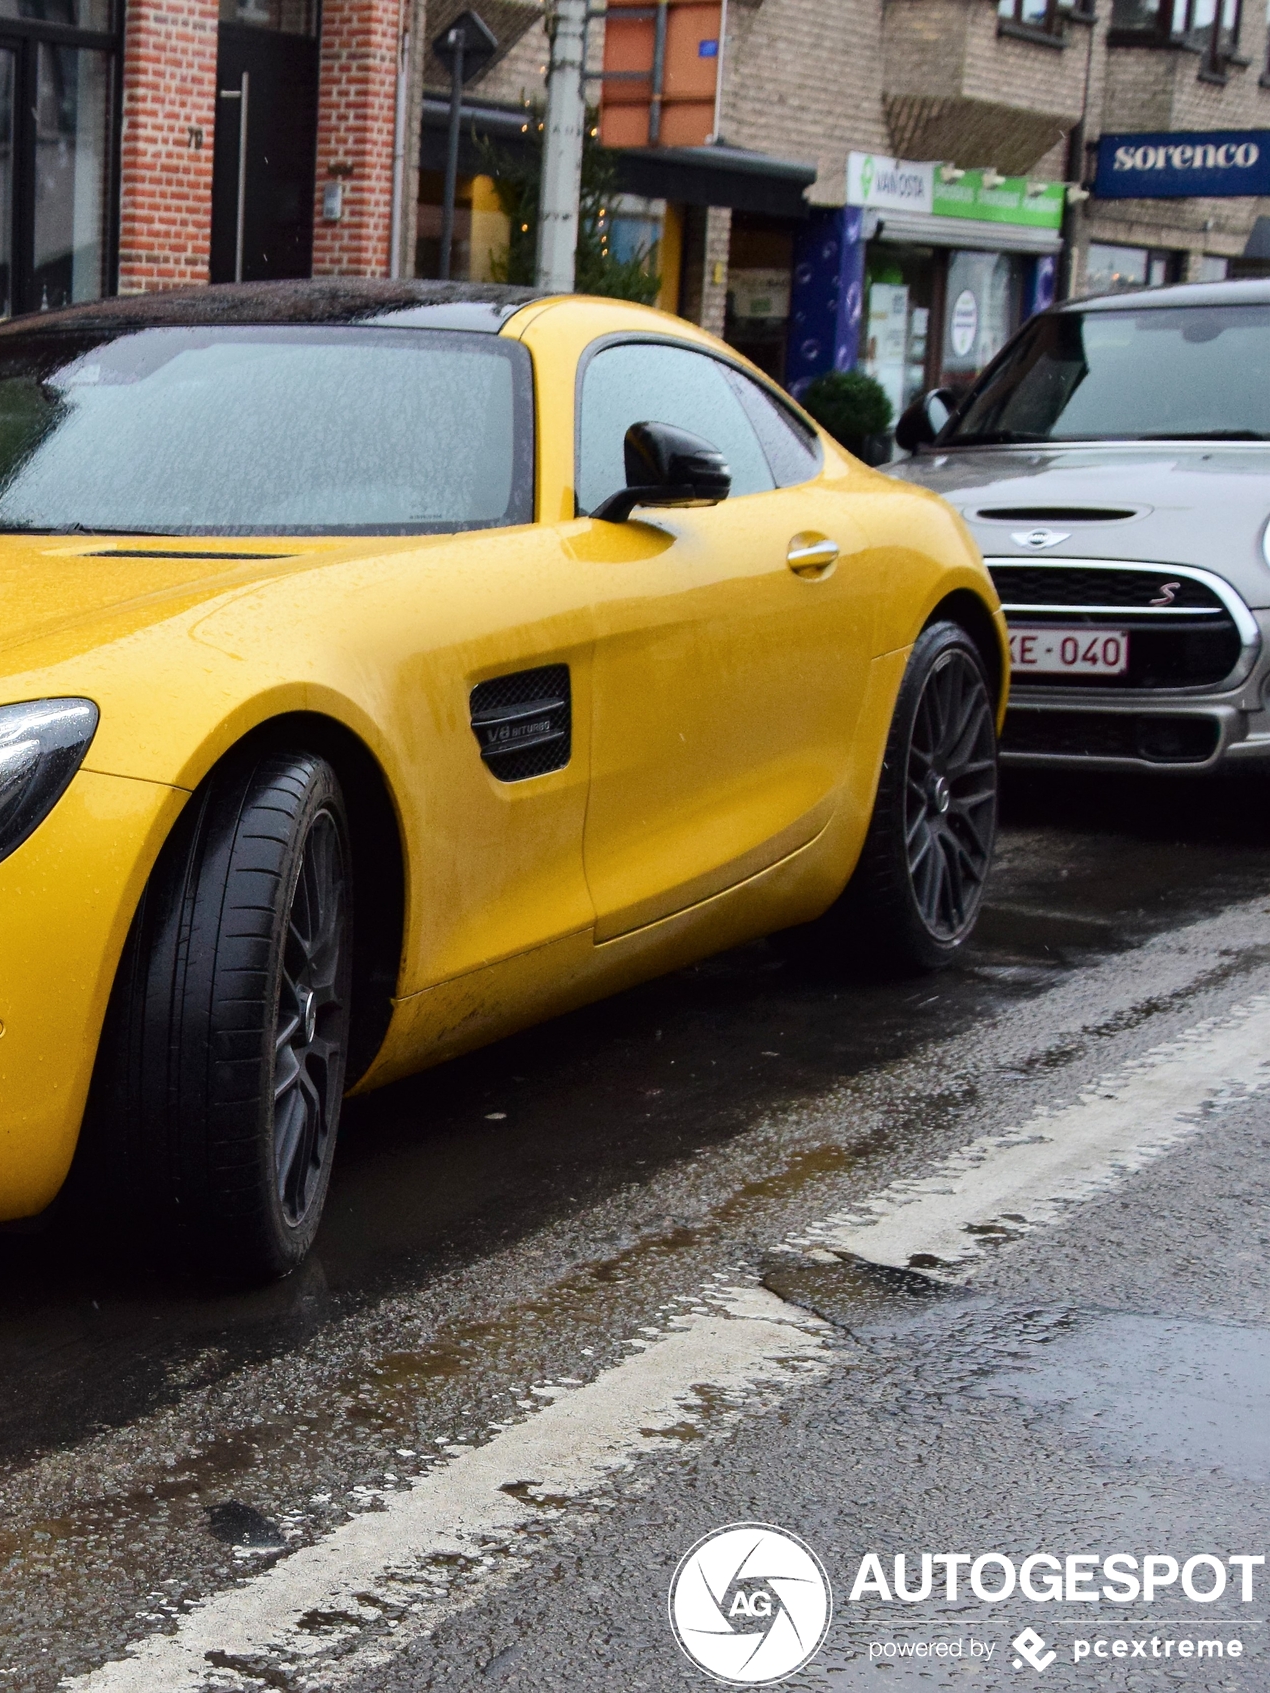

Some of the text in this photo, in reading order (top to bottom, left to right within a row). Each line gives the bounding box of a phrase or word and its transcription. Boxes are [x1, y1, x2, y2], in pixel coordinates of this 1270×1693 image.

[1113, 142, 1260, 171] sorenco
[487, 720, 550, 742] V8 BITURBO
